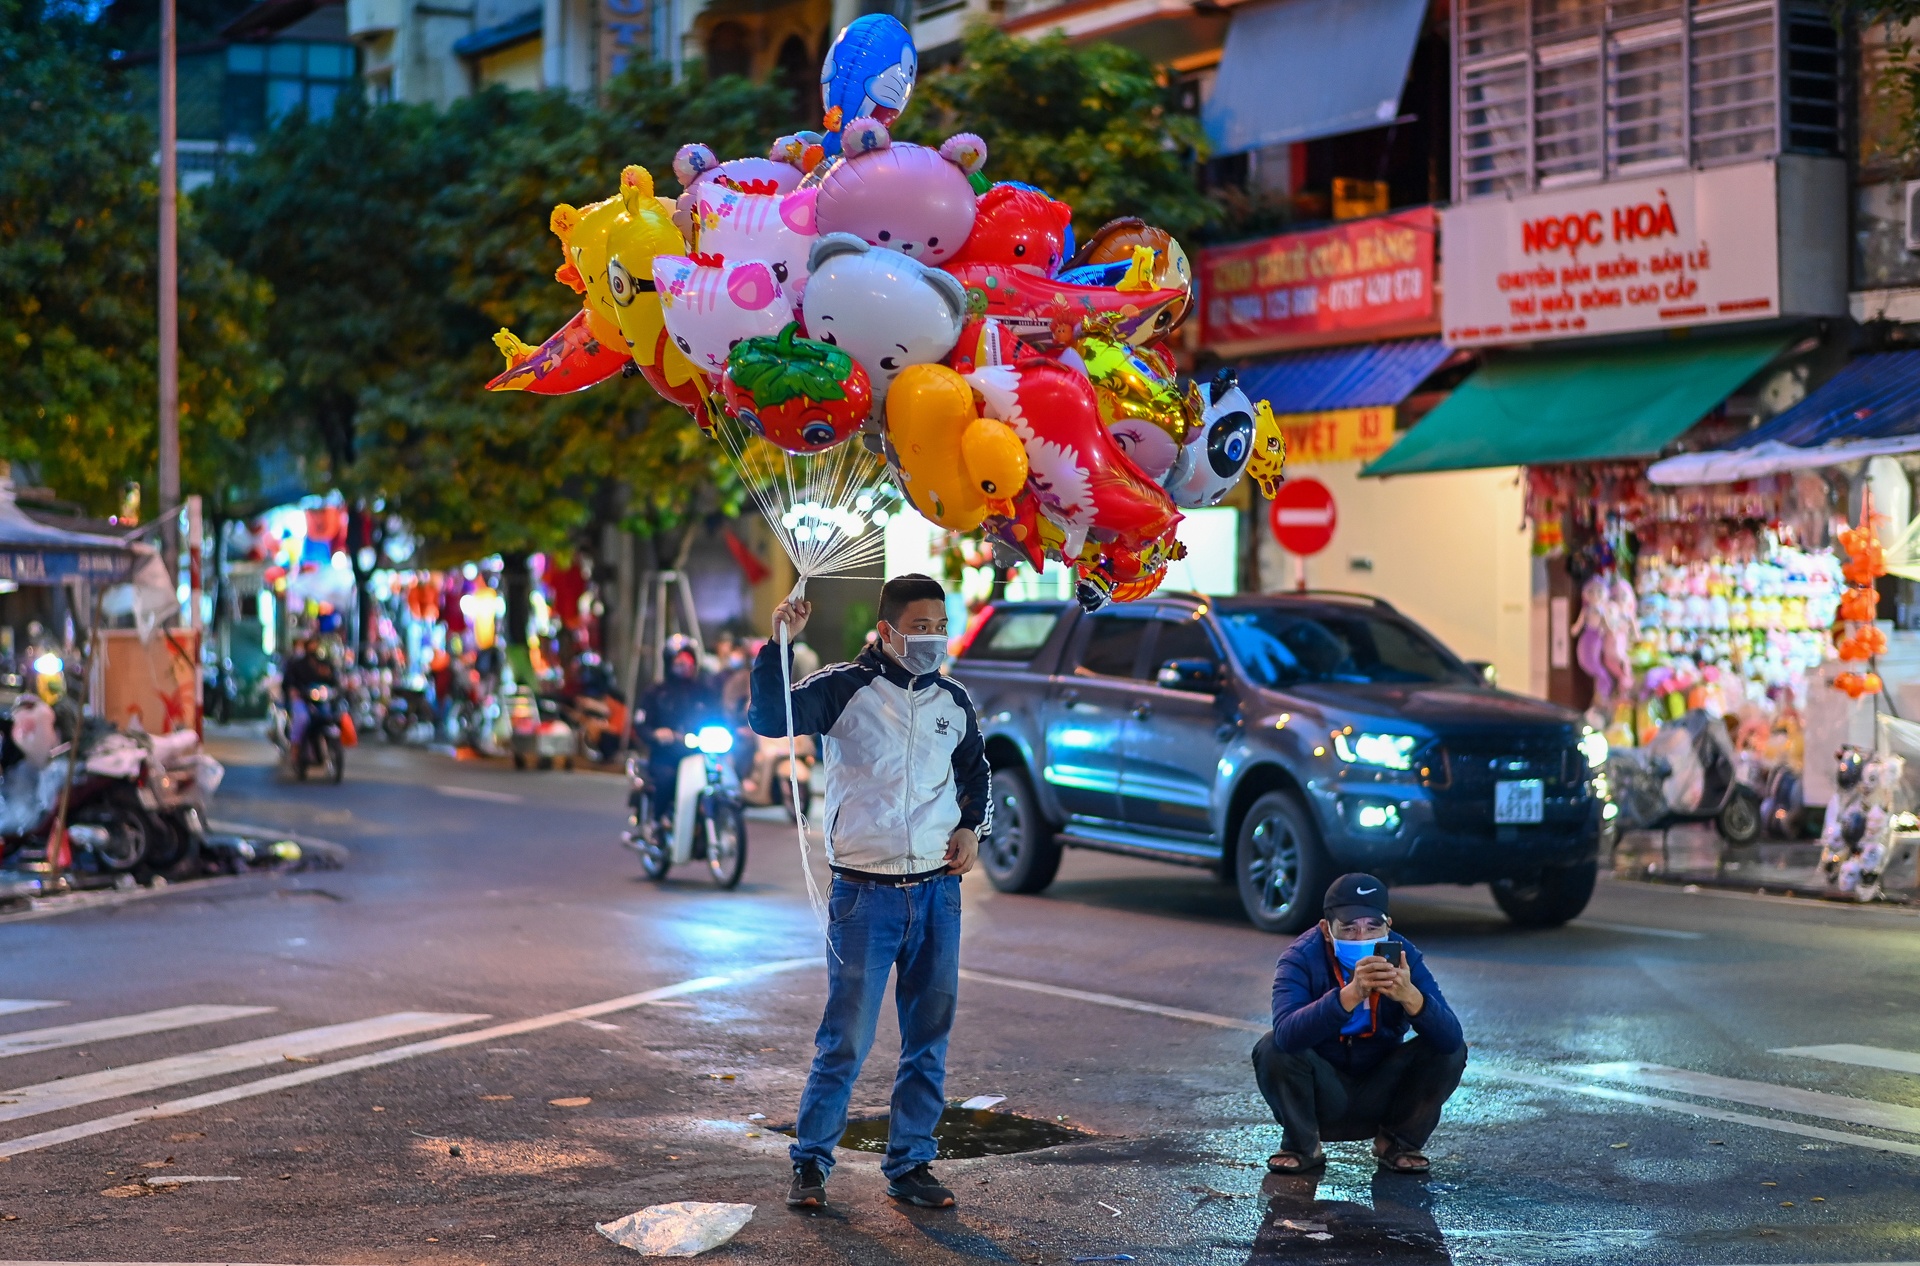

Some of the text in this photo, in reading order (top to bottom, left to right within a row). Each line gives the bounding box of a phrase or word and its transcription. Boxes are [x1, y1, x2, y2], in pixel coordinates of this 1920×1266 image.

[1522, 187, 1678, 256] NGỌC HOÀ
[1651, 247, 1684, 275] BÁN
[1627, 282, 1660, 305] CAO
